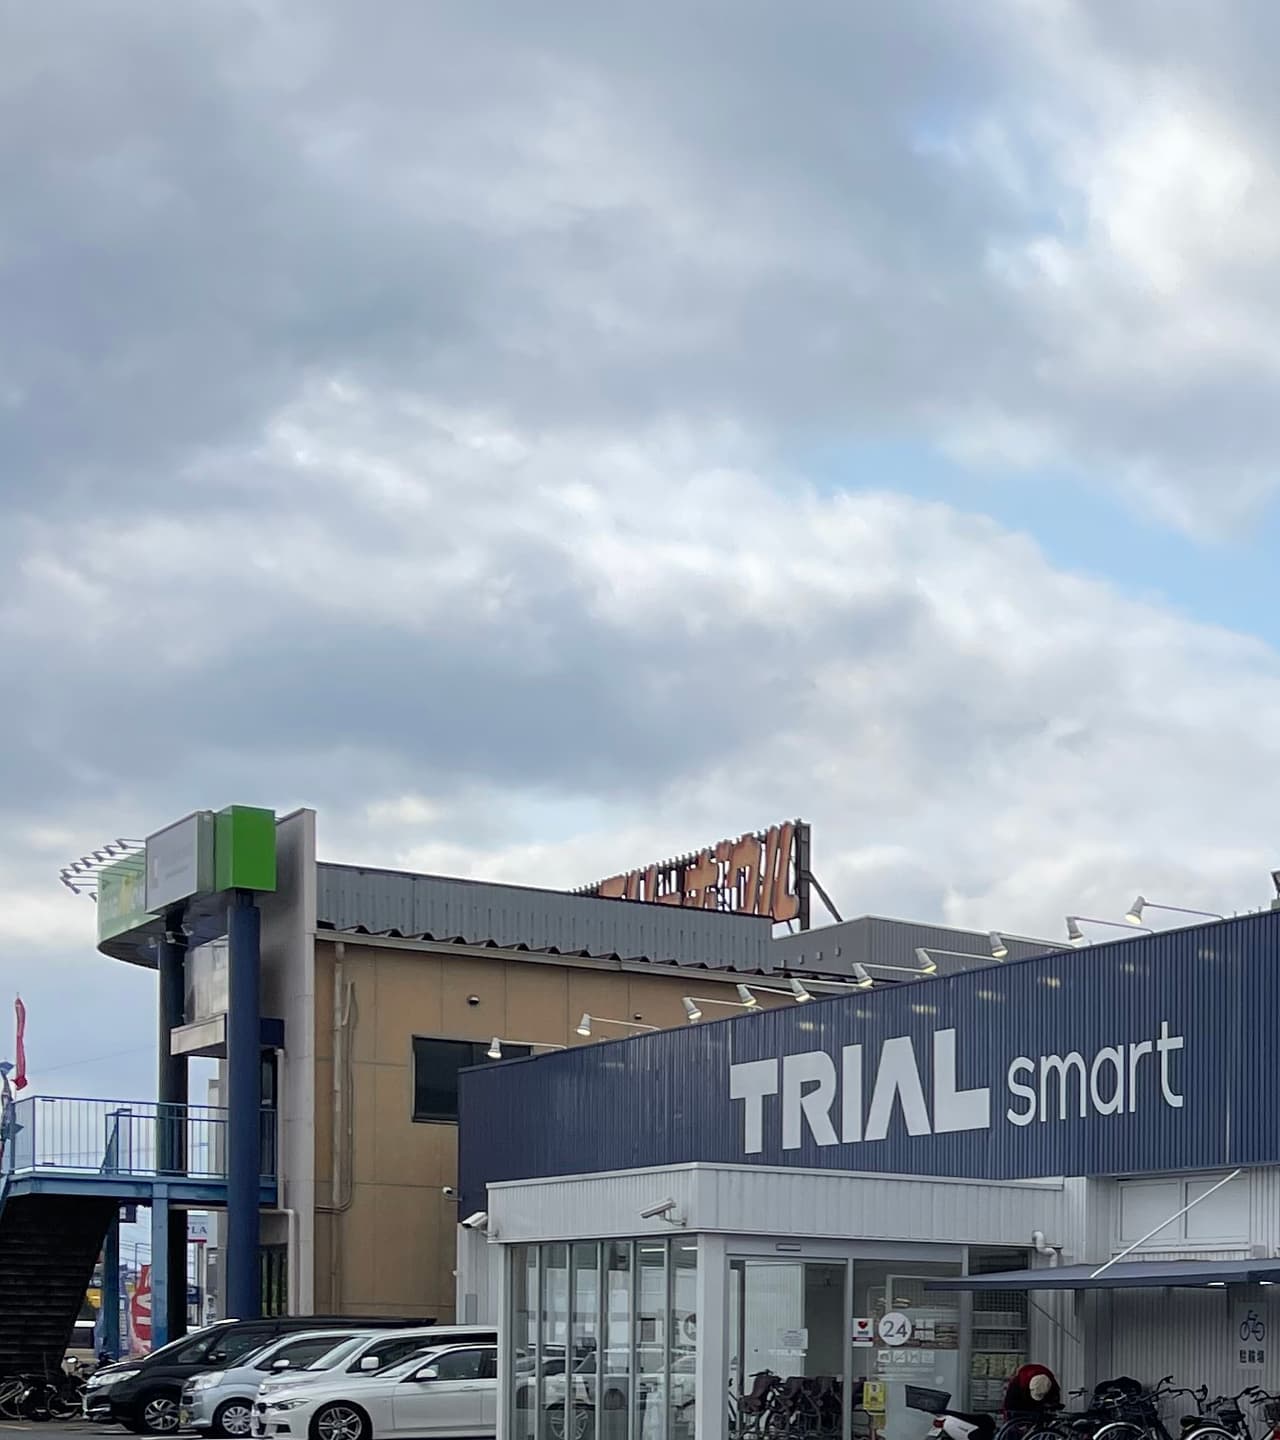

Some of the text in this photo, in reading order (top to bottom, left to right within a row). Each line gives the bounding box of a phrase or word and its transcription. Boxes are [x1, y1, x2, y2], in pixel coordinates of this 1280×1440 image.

[730, 1020, 1184, 1153] TRIAL smart
[882, 1320, 908, 1338] 24
